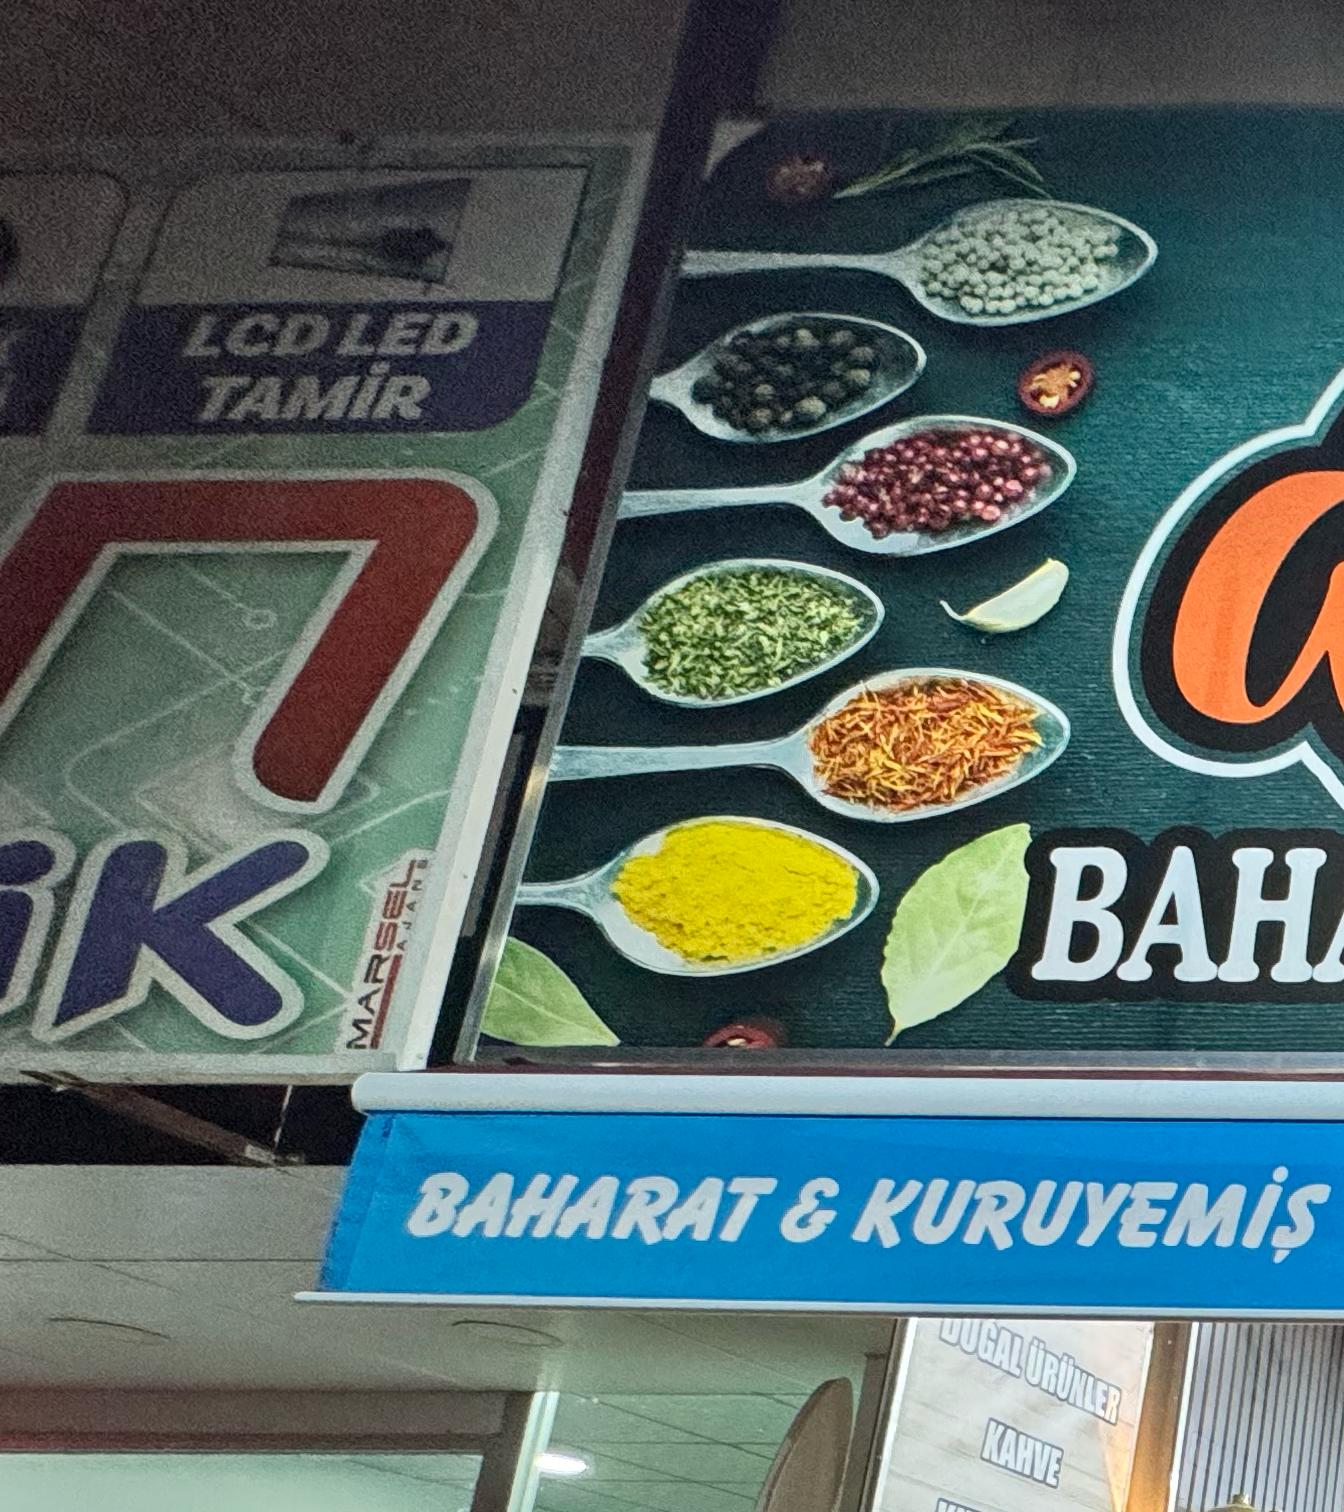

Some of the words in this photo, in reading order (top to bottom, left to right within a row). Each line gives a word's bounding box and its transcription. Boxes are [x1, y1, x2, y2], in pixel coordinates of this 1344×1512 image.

[181, 312, 330, 357] LCD
[336, 310, 480, 357] LED
[199, 361, 432, 421] TAMİR
[346, 859, 418, 1050] MARSEL
[407, 1171, 778, 1246] BAHARAT
[779, 1178, 837, 1240] &
[851, 1165, 1332, 1263] KURUYEMİŞ
[1024, 1336, 1123, 1427] ÜRÜNLER
[980, 1416, 1065, 1490] KAHVE
